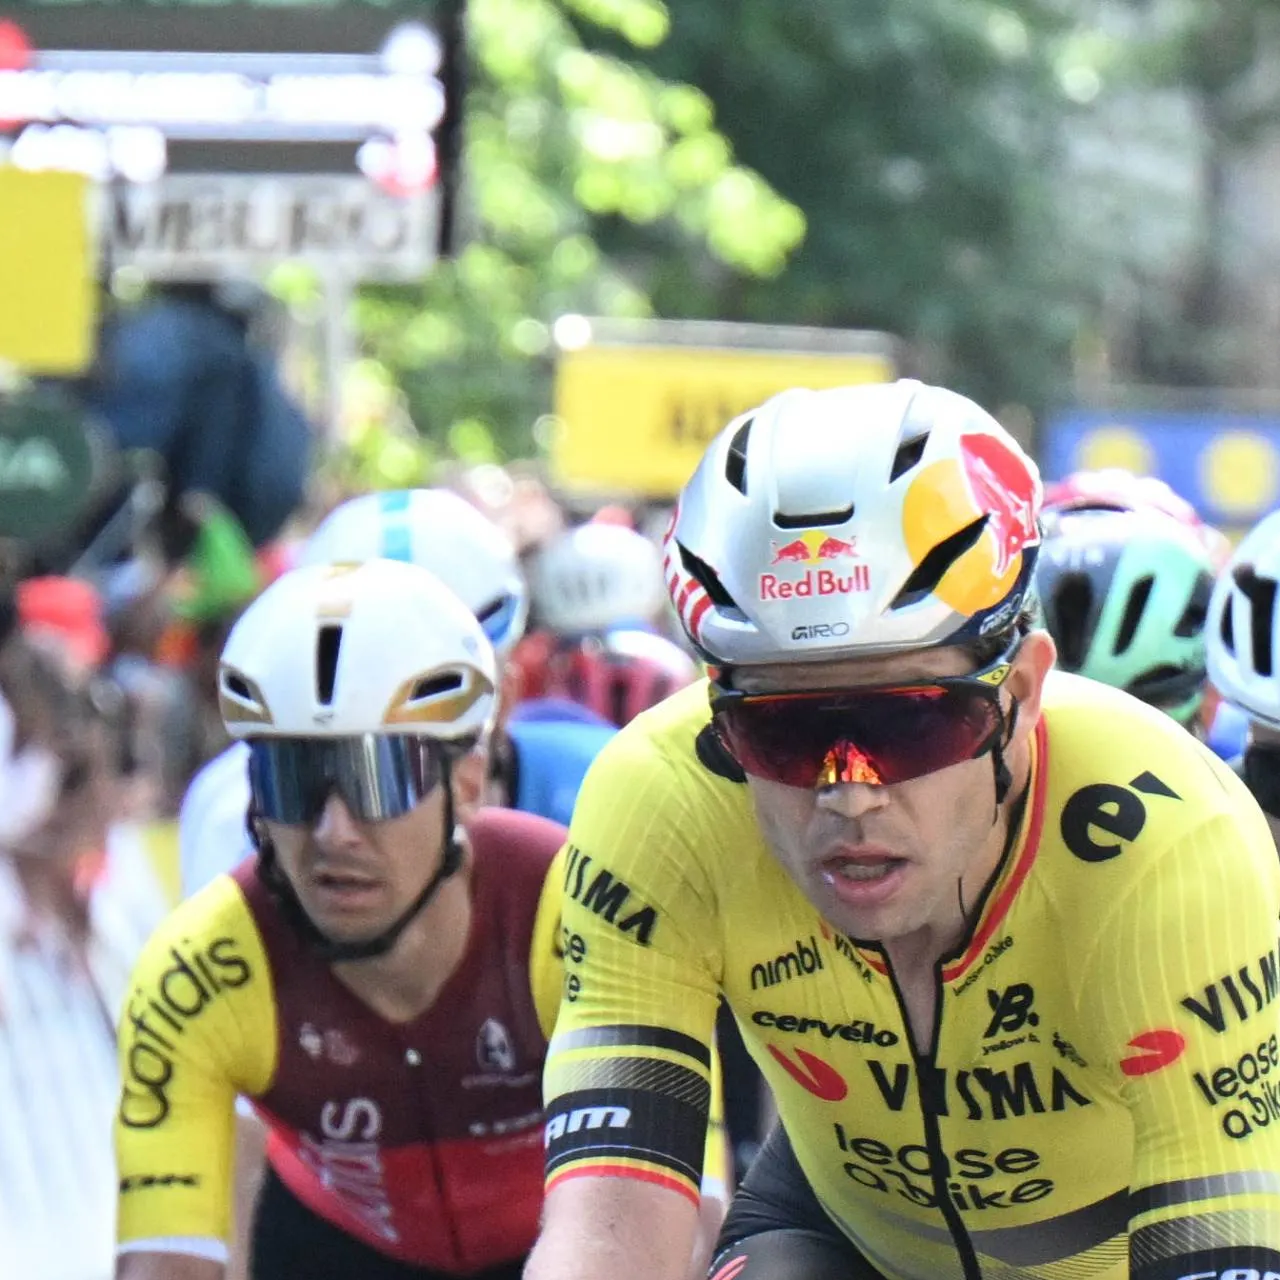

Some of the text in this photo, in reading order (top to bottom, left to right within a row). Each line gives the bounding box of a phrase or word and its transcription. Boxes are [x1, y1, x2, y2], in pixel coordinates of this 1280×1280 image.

[760, 566, 870, 601] Red Bull
[791, 622, 849, 641] GIRO
[564, 844, 657, 947] ISMA
[751, 936, 824, 990] nimbl
[121, 934, 252, 1130] cofidis
[751, 1010, 899, 1048] cervélo
[867, 1059, 1094, 1121] VISMA
[1193, 1033, 1279, 1106] lease
[834, 1122, 1040, 1180] lease
